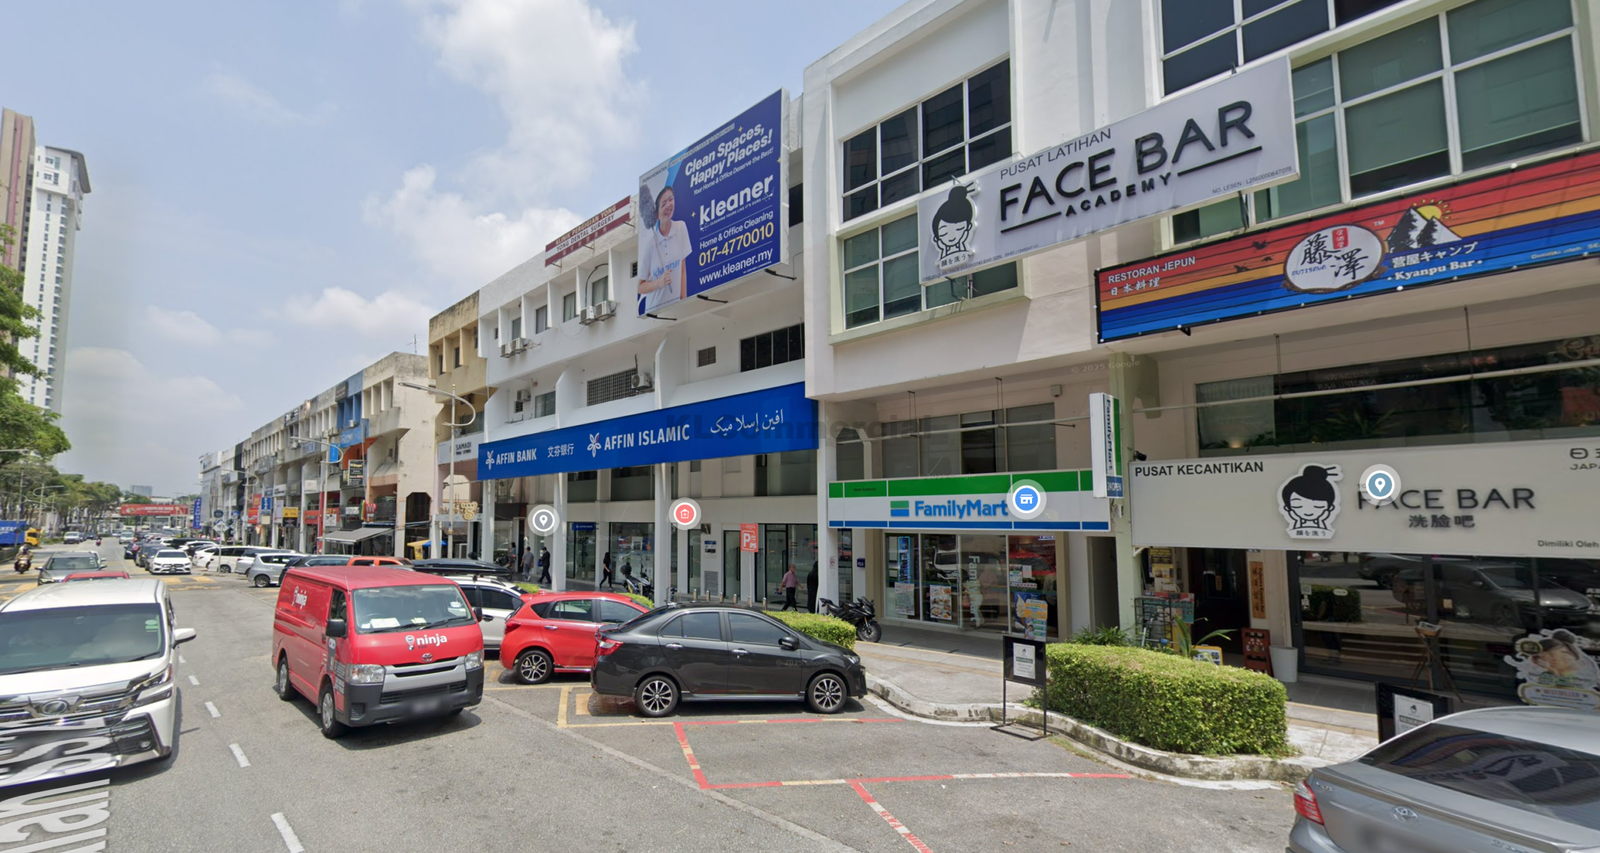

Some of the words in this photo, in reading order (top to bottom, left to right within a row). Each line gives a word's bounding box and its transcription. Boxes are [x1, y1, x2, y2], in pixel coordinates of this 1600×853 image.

[685, 152, 715, 177] Clean
[717, 123, 764, 158] Spaces,
[690, 160, 726, 188] Happy
[726, 128, 773, 168] Places!
[999, 147, 1118, 221] FACE
[1135, 100, 1256, 175] BAR
[1000, 156, 1045, 180] PUSAT
[1047, 128, 1111, 161] LATIHAN
[693, 186, 702, 195] Your
[702, 180, 716, 192] Home
[719, 171, 733, 182] Office
[1065, 172, 1172, 217] ACADEMY
[700, 174, 774, 225] kleaner
[556, 231, 571, 245] KLINIK
[601, 204, 617, 218] YONG
[556, 240, 570, 251] YONG
[570, 230, 589, 244] DENTAL
[590, 214, 614, 232] SURGERY
[700, 237, 717, 250] Home
[718, 233, 723, 241] &
[723, 224, 743, 239] Office
[744, 210, 774, 229] Cleaning
[698, 222, 774, 267] 017-4770010
[699, 248, 774, 285] www.kleaner.my
[1107, 265, 1161, 285] RESTORAN
[1162, 256, 1197, 273] JEPUN
[1394, 265, 1447, 281] Kyanpu
[1449, 258, 1476, 271] Bar
[1109, 276, 1161, 298] 日本料理
[604, 433, 635, 452] AFFIN
[638, 424, 691, 446] ISLAMIC
[1105, 398, 1114, 470] FamilyMart
[495, 451, 516, 466] AFFIN
[516, 448, 537, 462] BANK
[1134, 463, 1174, 476] PUSAT
[1176, 461, 1264, 475] KECANTIKAN
[914, 500, 1008, 519] FamilyMart
[1358, 489, 1444, 510] FACE
[1457, 488, 1536, 510] BAR
[1408, 514, 1475, 528] 洗脸吧
[743, 532, 751, 548] P
[1538, 540, 1574, 548] Dimiliki
[1576, 540, 1598, 548] Oleh
[296, 590, 307, 609] ninja
[416, 633, 448, 648] ninja
